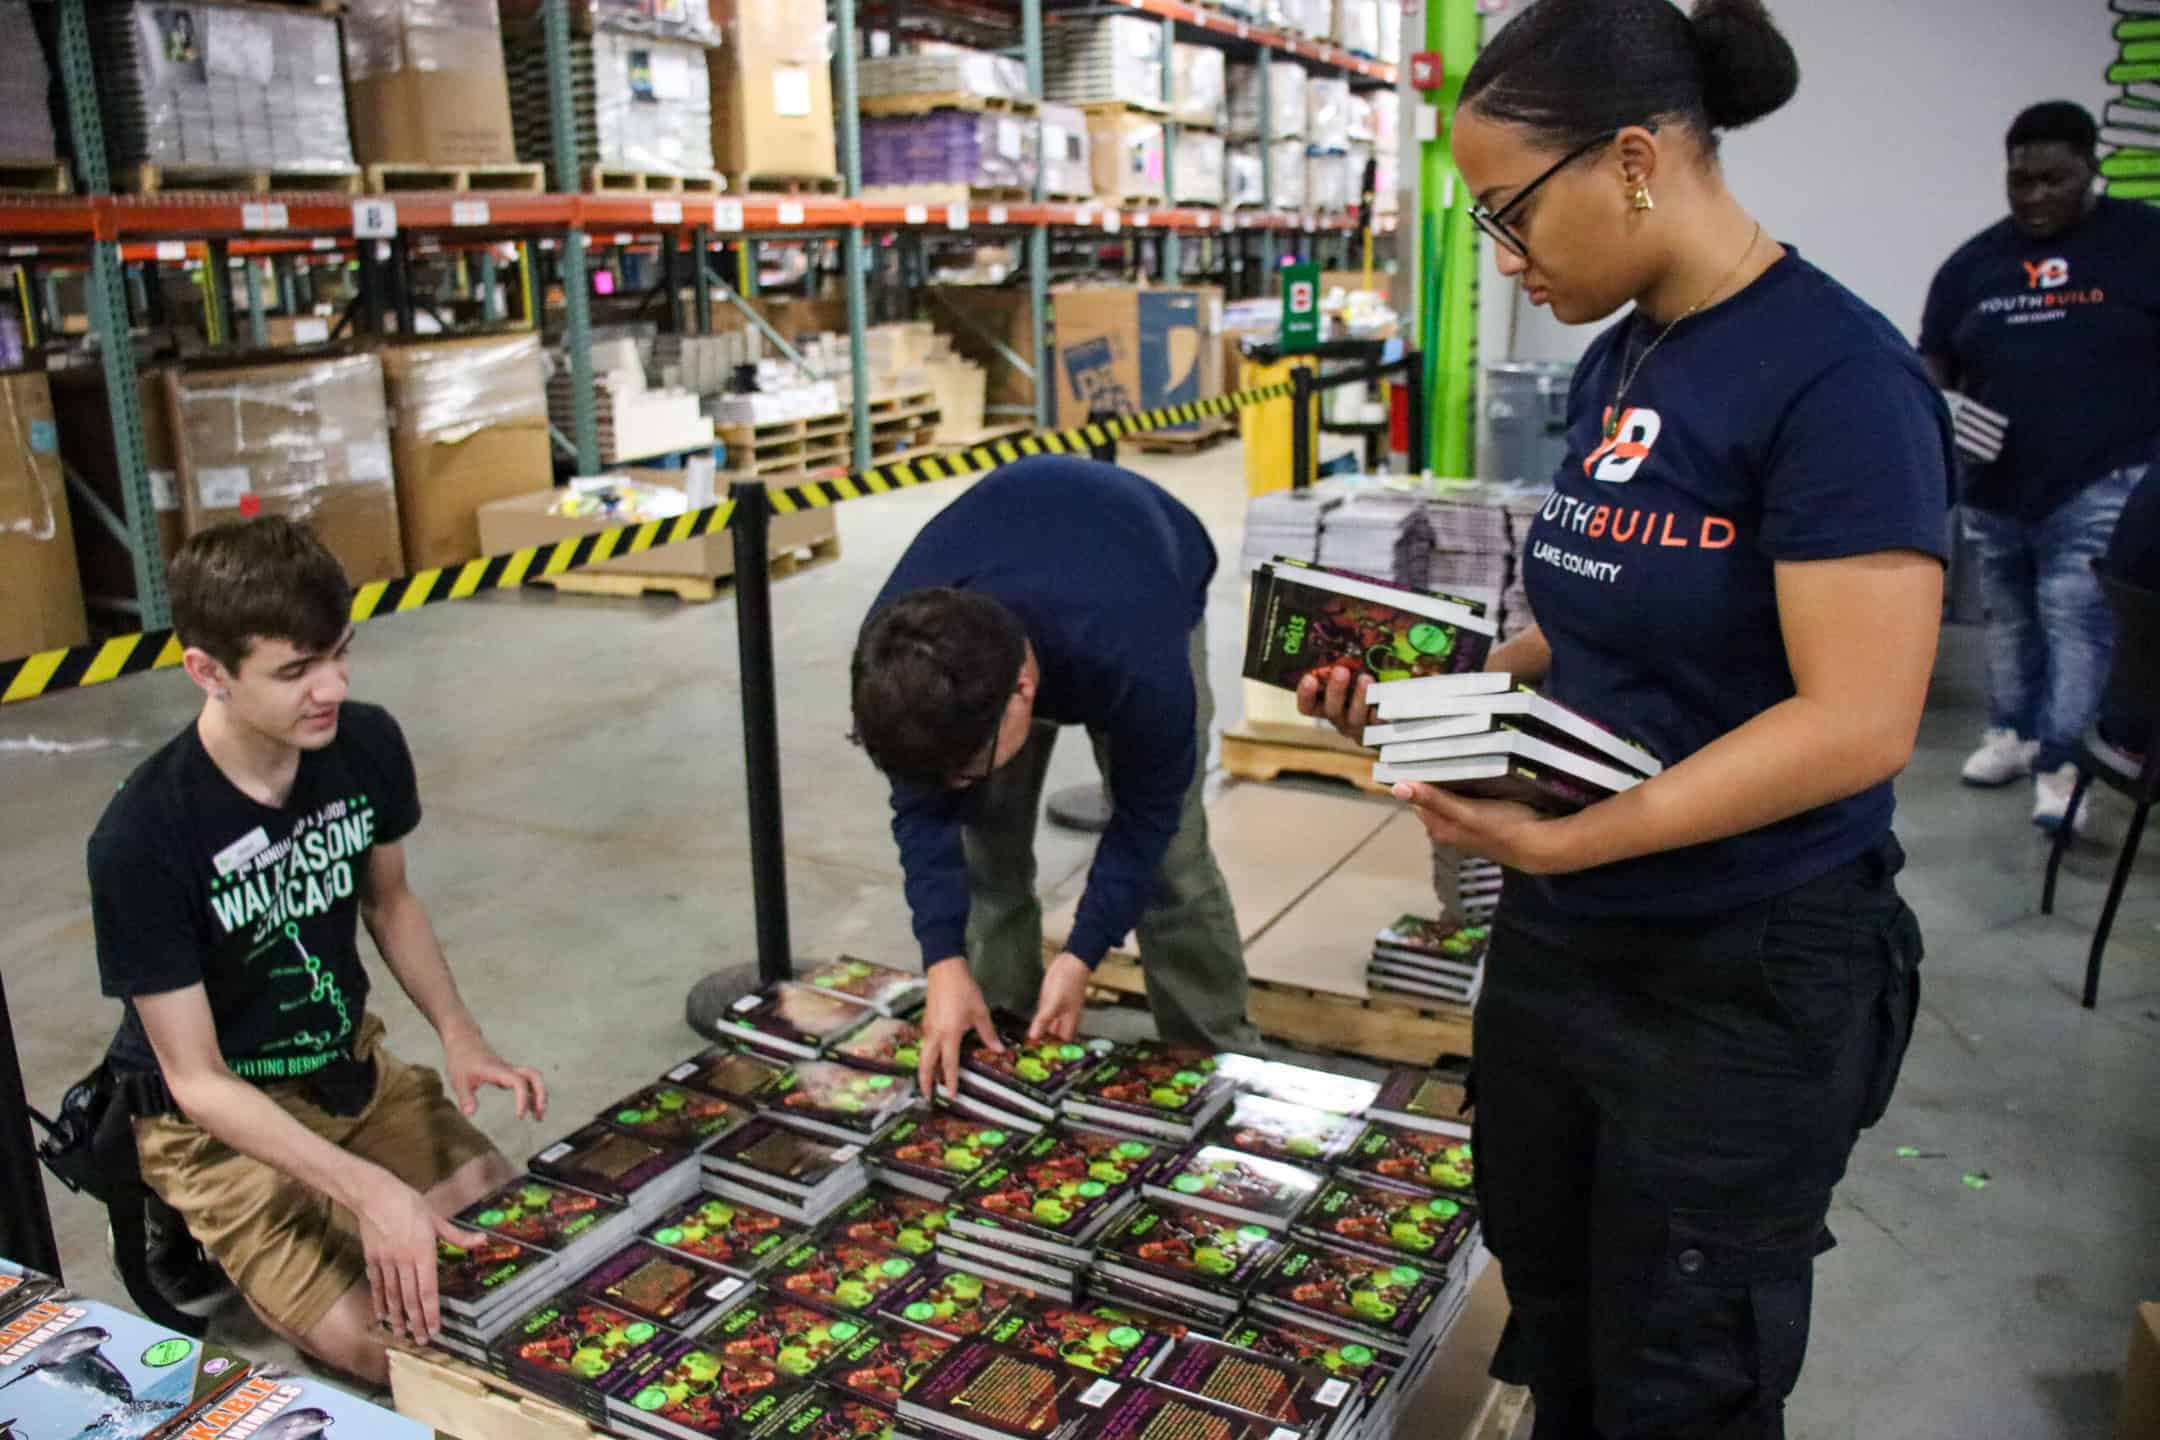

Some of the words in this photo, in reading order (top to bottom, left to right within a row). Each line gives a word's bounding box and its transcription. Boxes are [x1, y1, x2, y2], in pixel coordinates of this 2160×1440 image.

[1542, 491, 1736, 548] UTHBUILD
[1533, 539, 1562, 567] LAKE
[1562, 552, 1622, 583] COUNTY
